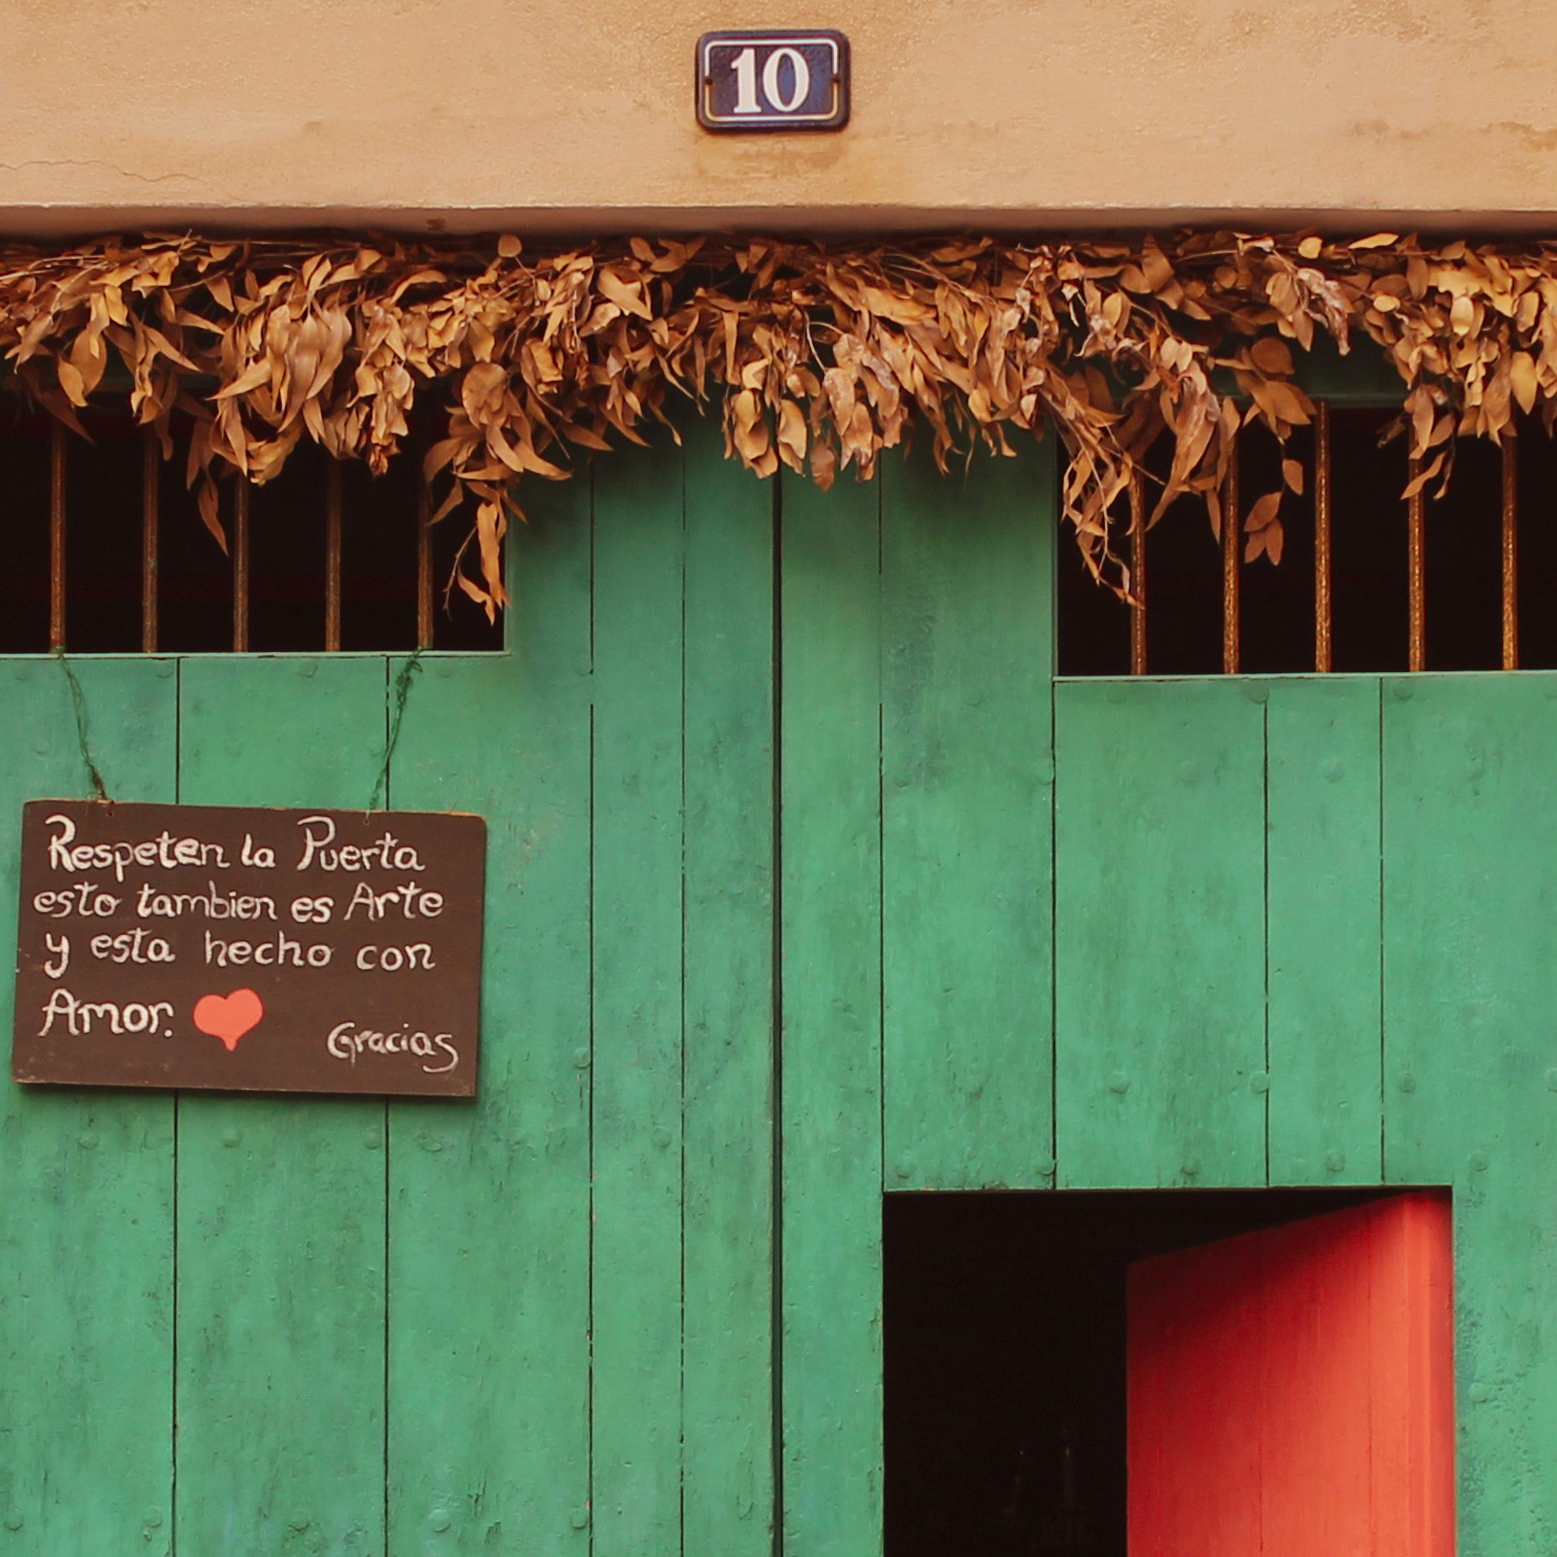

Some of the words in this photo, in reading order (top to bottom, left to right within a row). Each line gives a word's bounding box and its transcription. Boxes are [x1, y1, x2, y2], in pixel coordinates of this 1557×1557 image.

[730, 47, 810, 114] 10
[45, 814, 230, 882] Respeten
[241, 833, 276, 868] la
[297, 815, 425, 871] Puerta
[33, 881, 122, 918] esto
[137, 880, 277, 921] tambien
[291, 895, 333, 923] es
[343, 881, 444, 921] Arte
[45, 931, 70, 979] y
[90, 927, 175, 963] esta
[206, 930, 332, 967] hecho
[355, 943, 436, 971] con
[327, 1022, 459, 1073] Gracias
